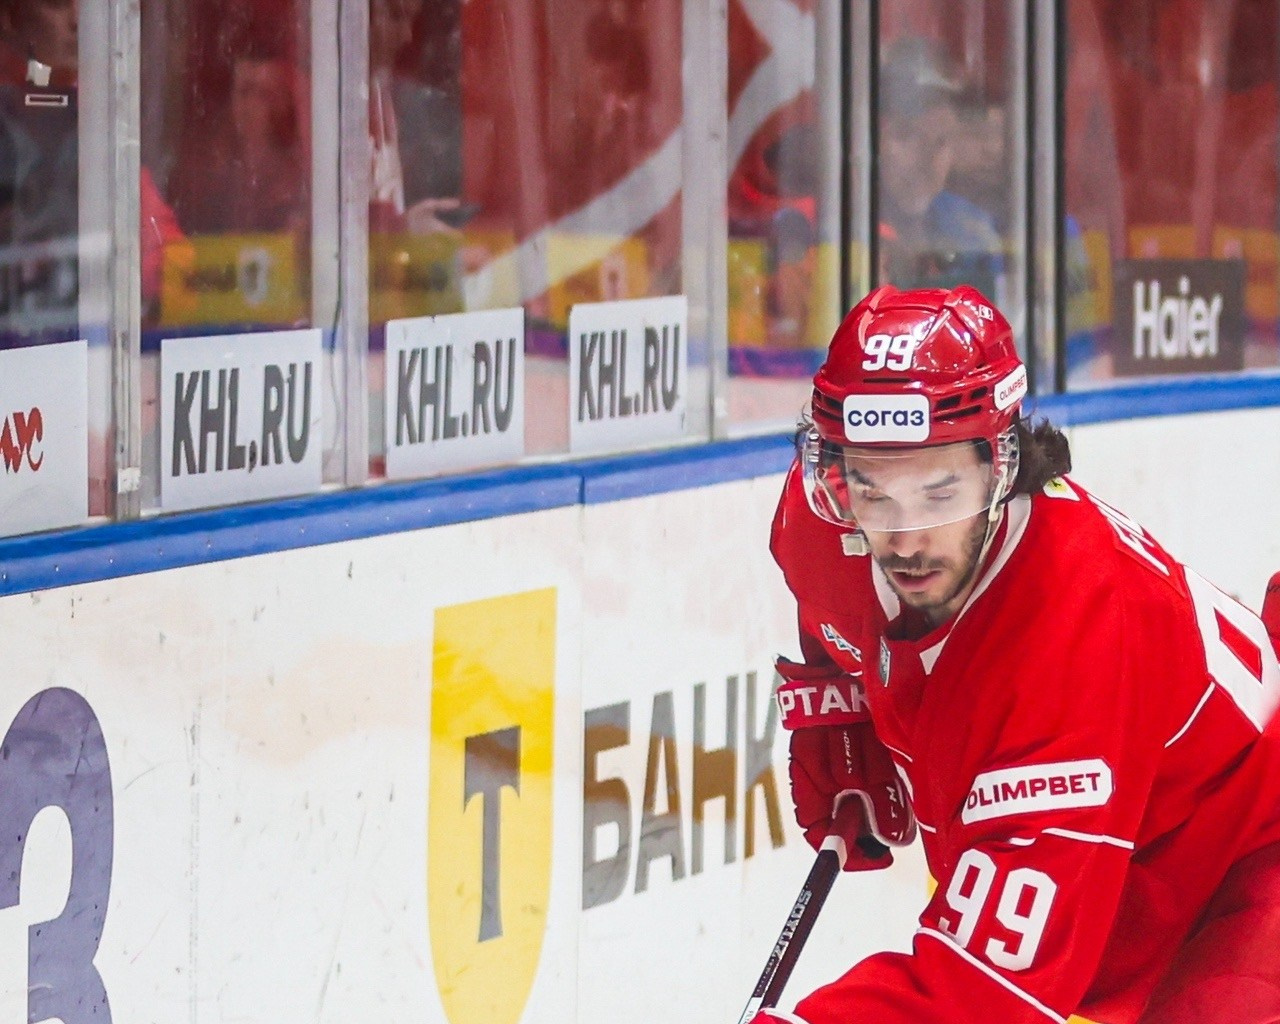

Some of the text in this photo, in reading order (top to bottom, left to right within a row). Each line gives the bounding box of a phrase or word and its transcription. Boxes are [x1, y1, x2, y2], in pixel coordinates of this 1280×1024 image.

[861, 334, 916, 372] 99
[1132, 276, 1224, 358] Haier
[172, 360, 313, 477] KHL.RU
[395, 337, 517, 447] KHL.RU
[578, 323, 681, 422] KHL.RU
[847, 409, 925, 427] согаз
[582, 669, 786, 911] БАНК
[966, 772, 1101, 810] OLIMPBET
[938, 848, 1058, 972] 99
